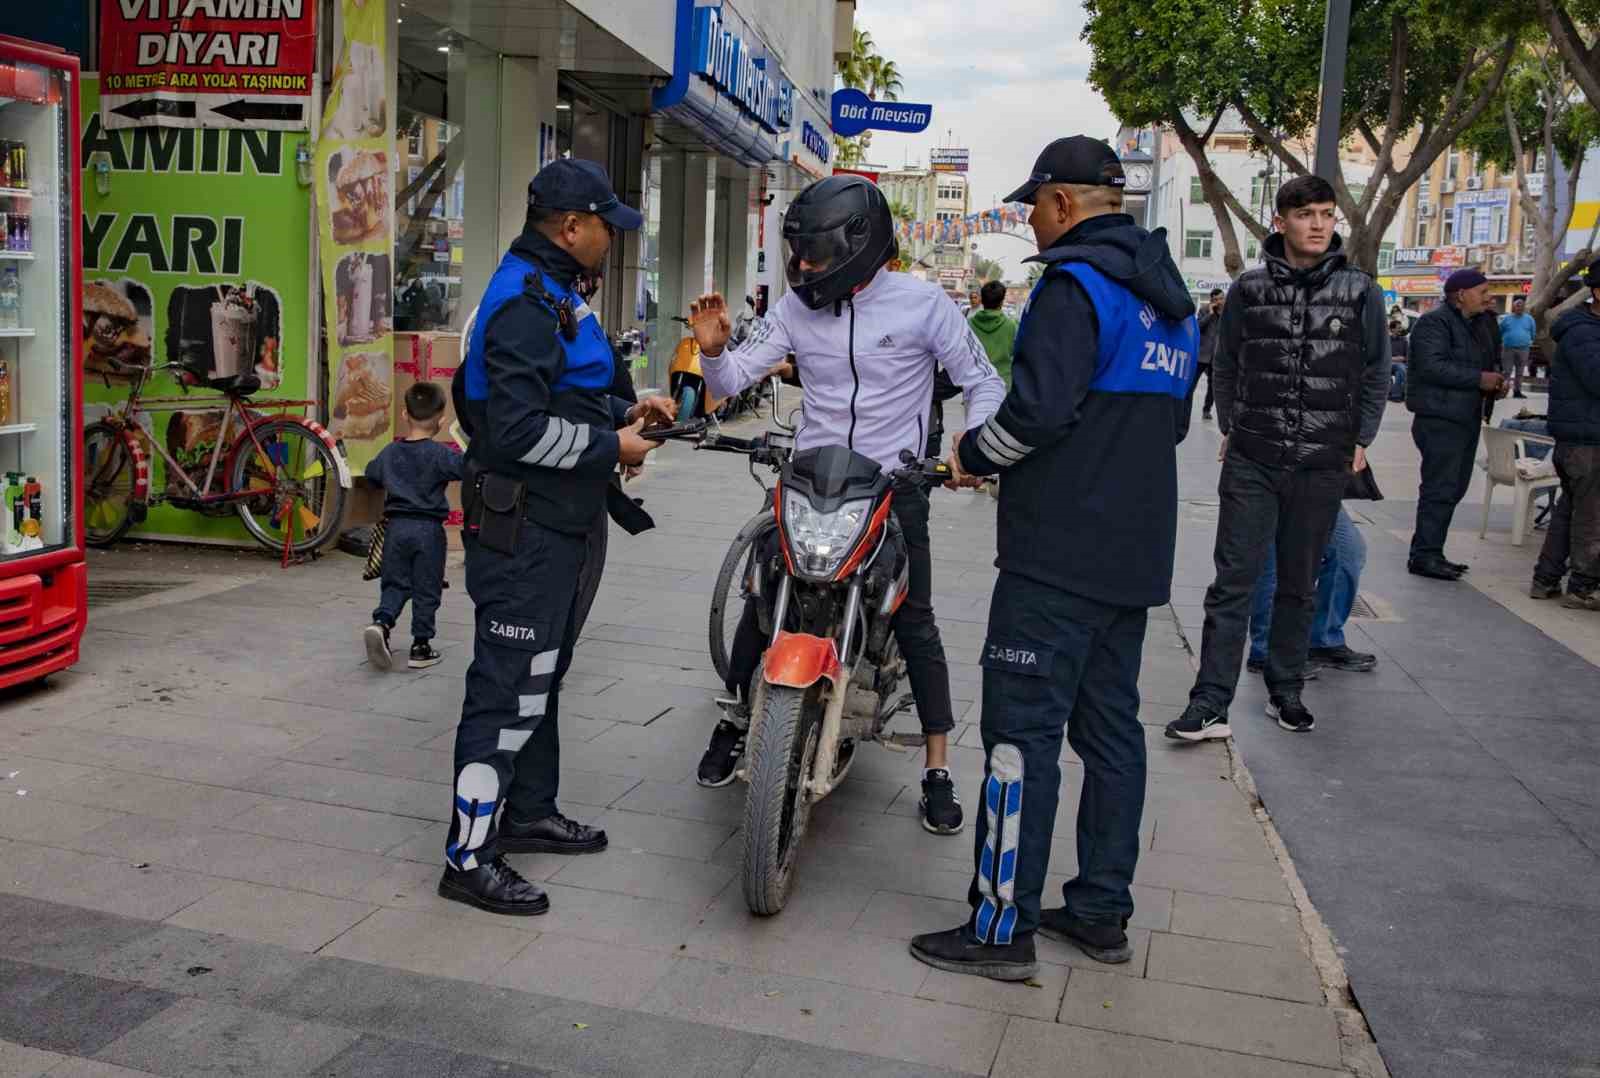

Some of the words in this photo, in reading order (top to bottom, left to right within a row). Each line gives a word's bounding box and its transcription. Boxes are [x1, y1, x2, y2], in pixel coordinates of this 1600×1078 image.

[137, 23, 280, 66] DİYARI
[107, 75, 121, 88] 10
[125, 72, 166, 88] METRE
[170, 73, 198, 87] ARA
[202, 74, 238, 88] YOLA
[241, 75, 307, 91] TAŞINDIK
[489, 620, 536, 641] ZABITA
[989, 645, 1037, 665] ZABITA
